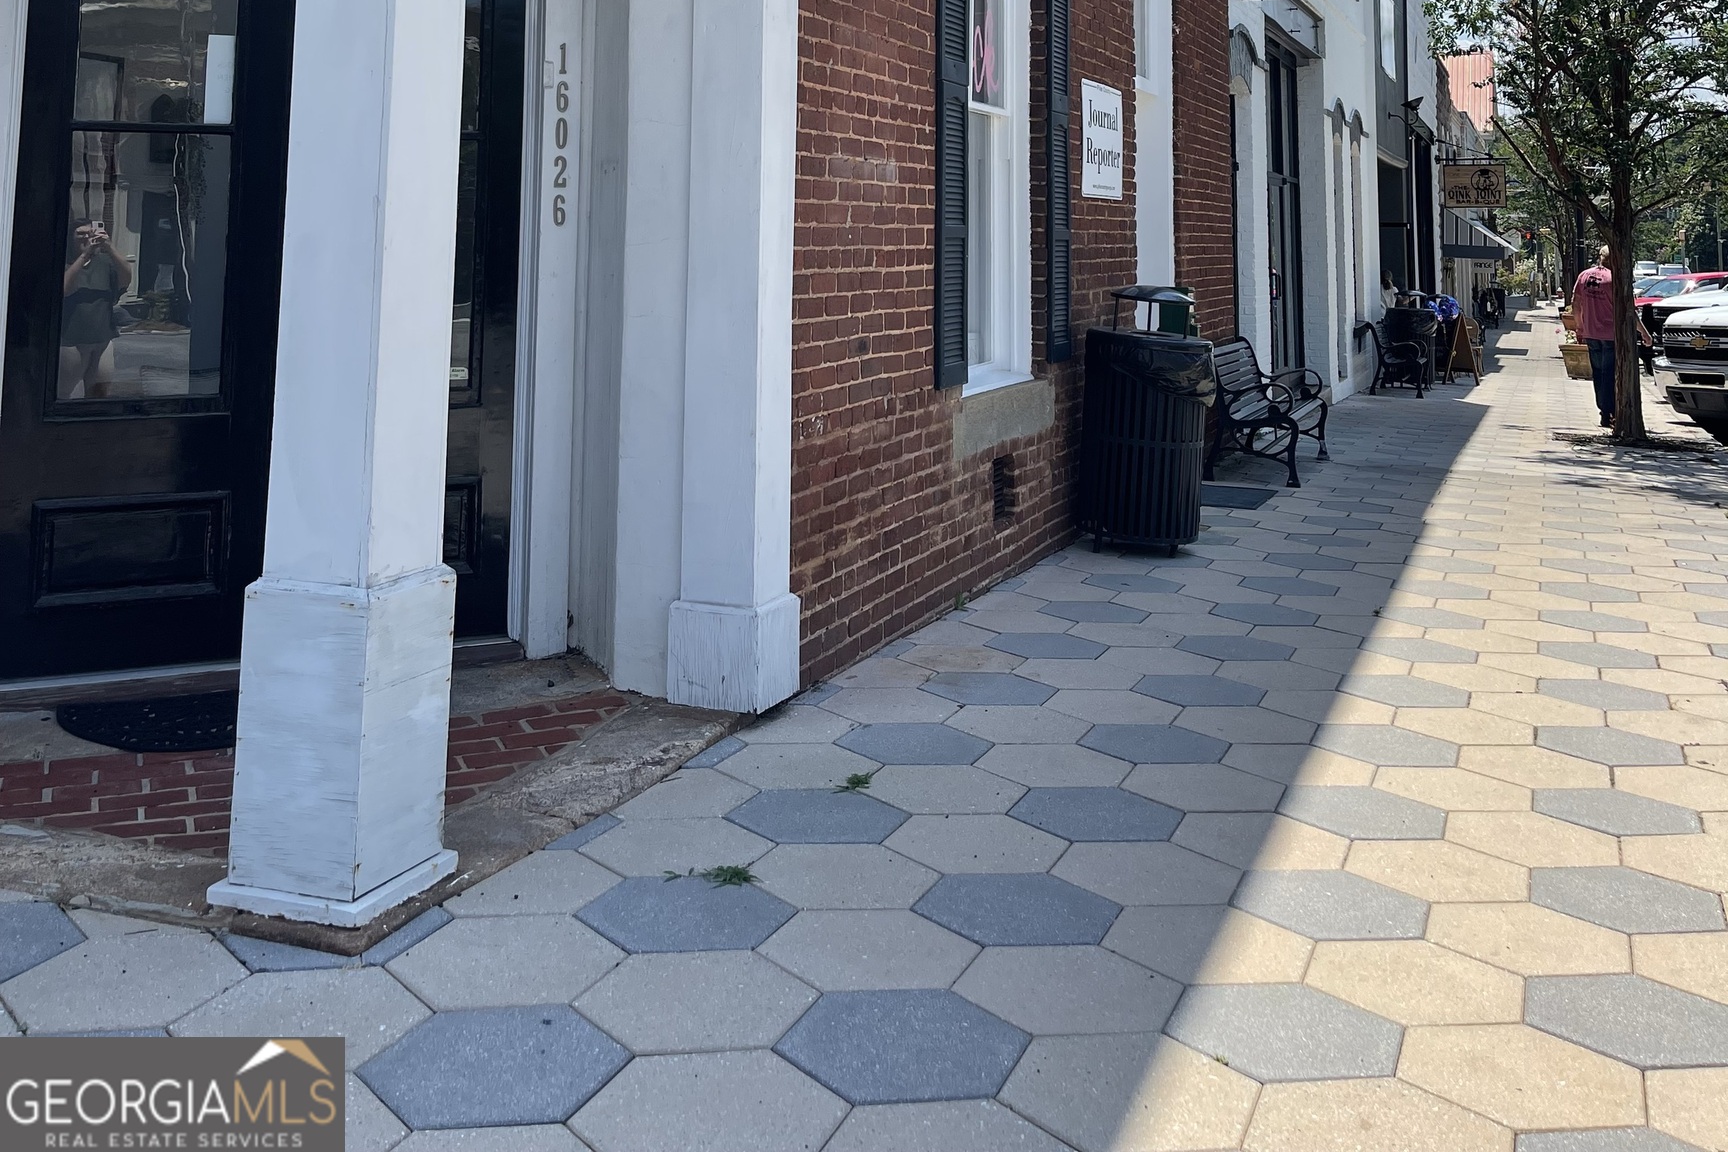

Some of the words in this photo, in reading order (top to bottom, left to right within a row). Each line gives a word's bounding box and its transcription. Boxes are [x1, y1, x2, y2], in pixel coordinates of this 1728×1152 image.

[1087, 98, 1119, 132] Journal
[552, 42, 569, 227] 16026
[1086, 136, 1121, 175] Reporter
[1474, 189, 1502, 200] JOINT
